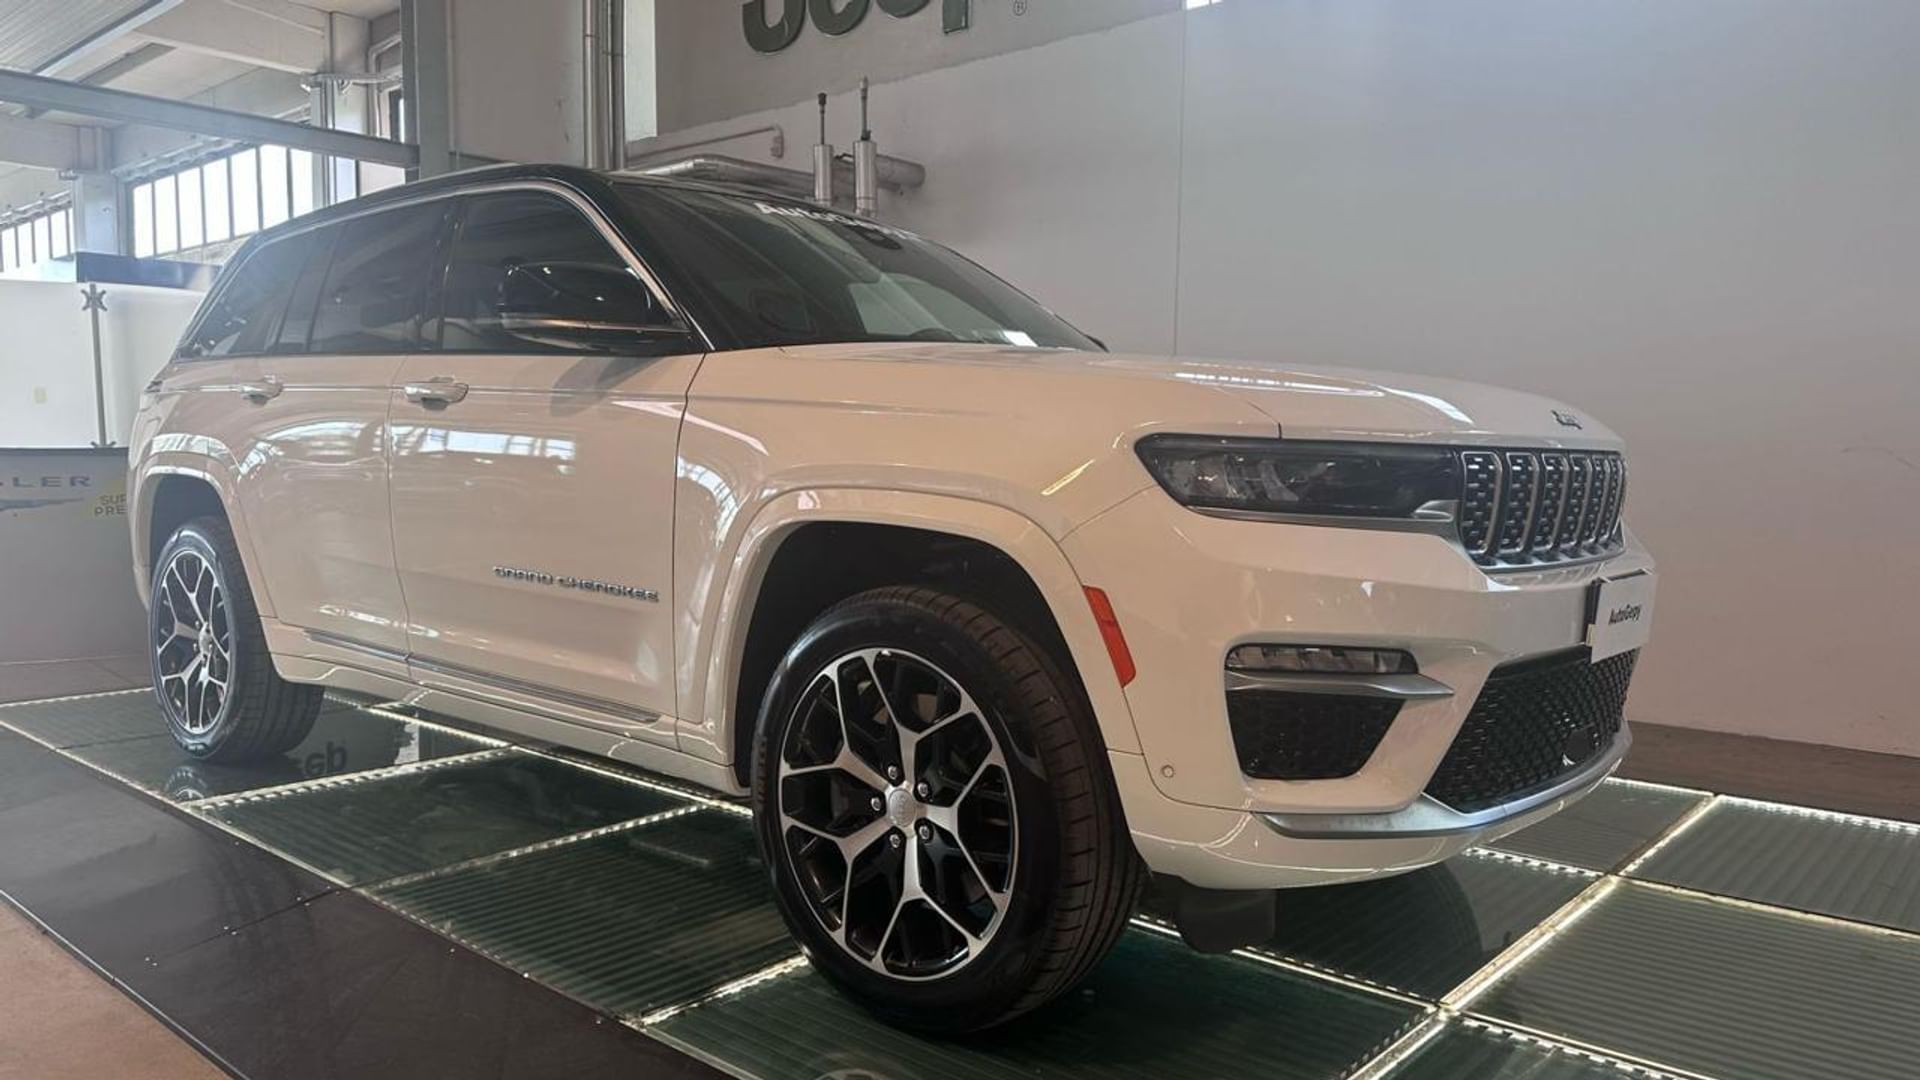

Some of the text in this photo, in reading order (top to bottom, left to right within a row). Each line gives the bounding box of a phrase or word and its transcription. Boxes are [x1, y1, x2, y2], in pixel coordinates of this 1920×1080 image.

[0, 476, 91, 488] LER
[493, 566, 659, 603] GRAND CHEROKEE
